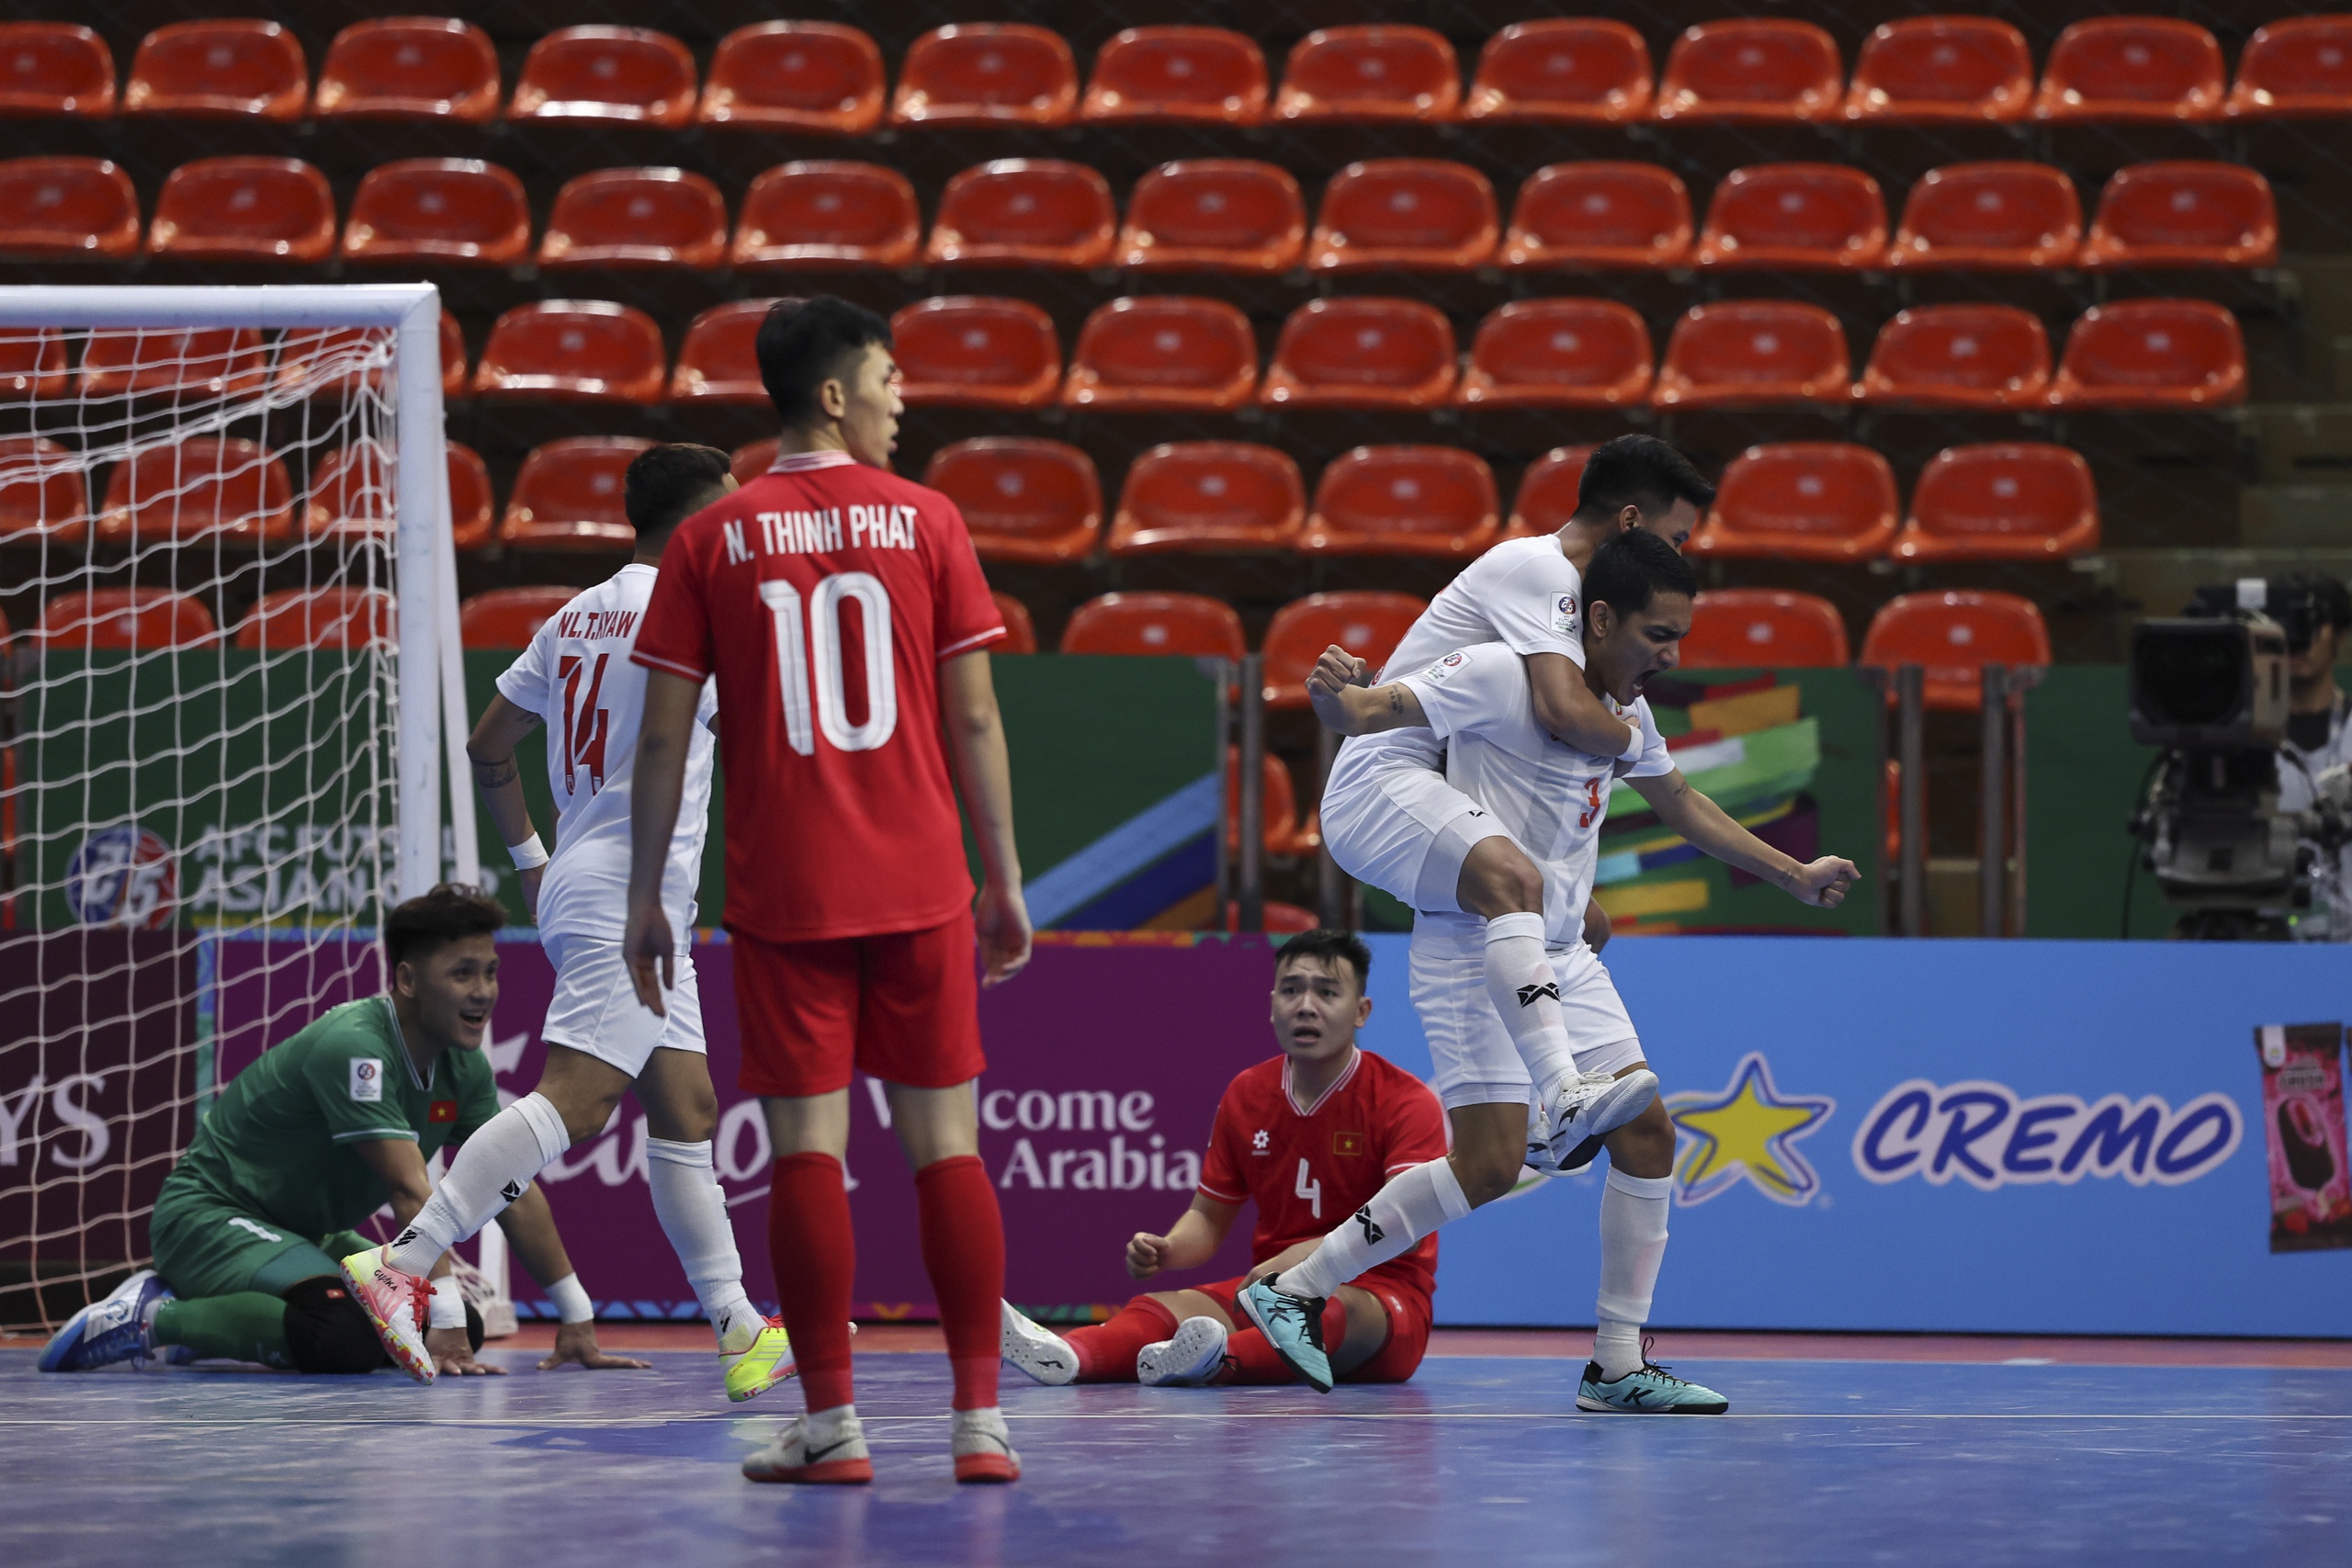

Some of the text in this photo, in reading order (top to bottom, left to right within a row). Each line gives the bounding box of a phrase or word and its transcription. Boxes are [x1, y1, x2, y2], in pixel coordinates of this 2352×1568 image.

[723, 504, 917, 566] N. THINH PHAT
[759, 570, 898, 757] 10
[558, 653, 610, 796] 14
[1579, 777, 1601, 829] 3
[195, 823, 458, 863] AFC FUTSL
[190, 864, 368, 912] ASIAN
[1000, 1134, 1202, 1190] Arabia
[1852, 1078, 2243, 1190] CREMO
[1295, 1156, 1321, 1220] 4
